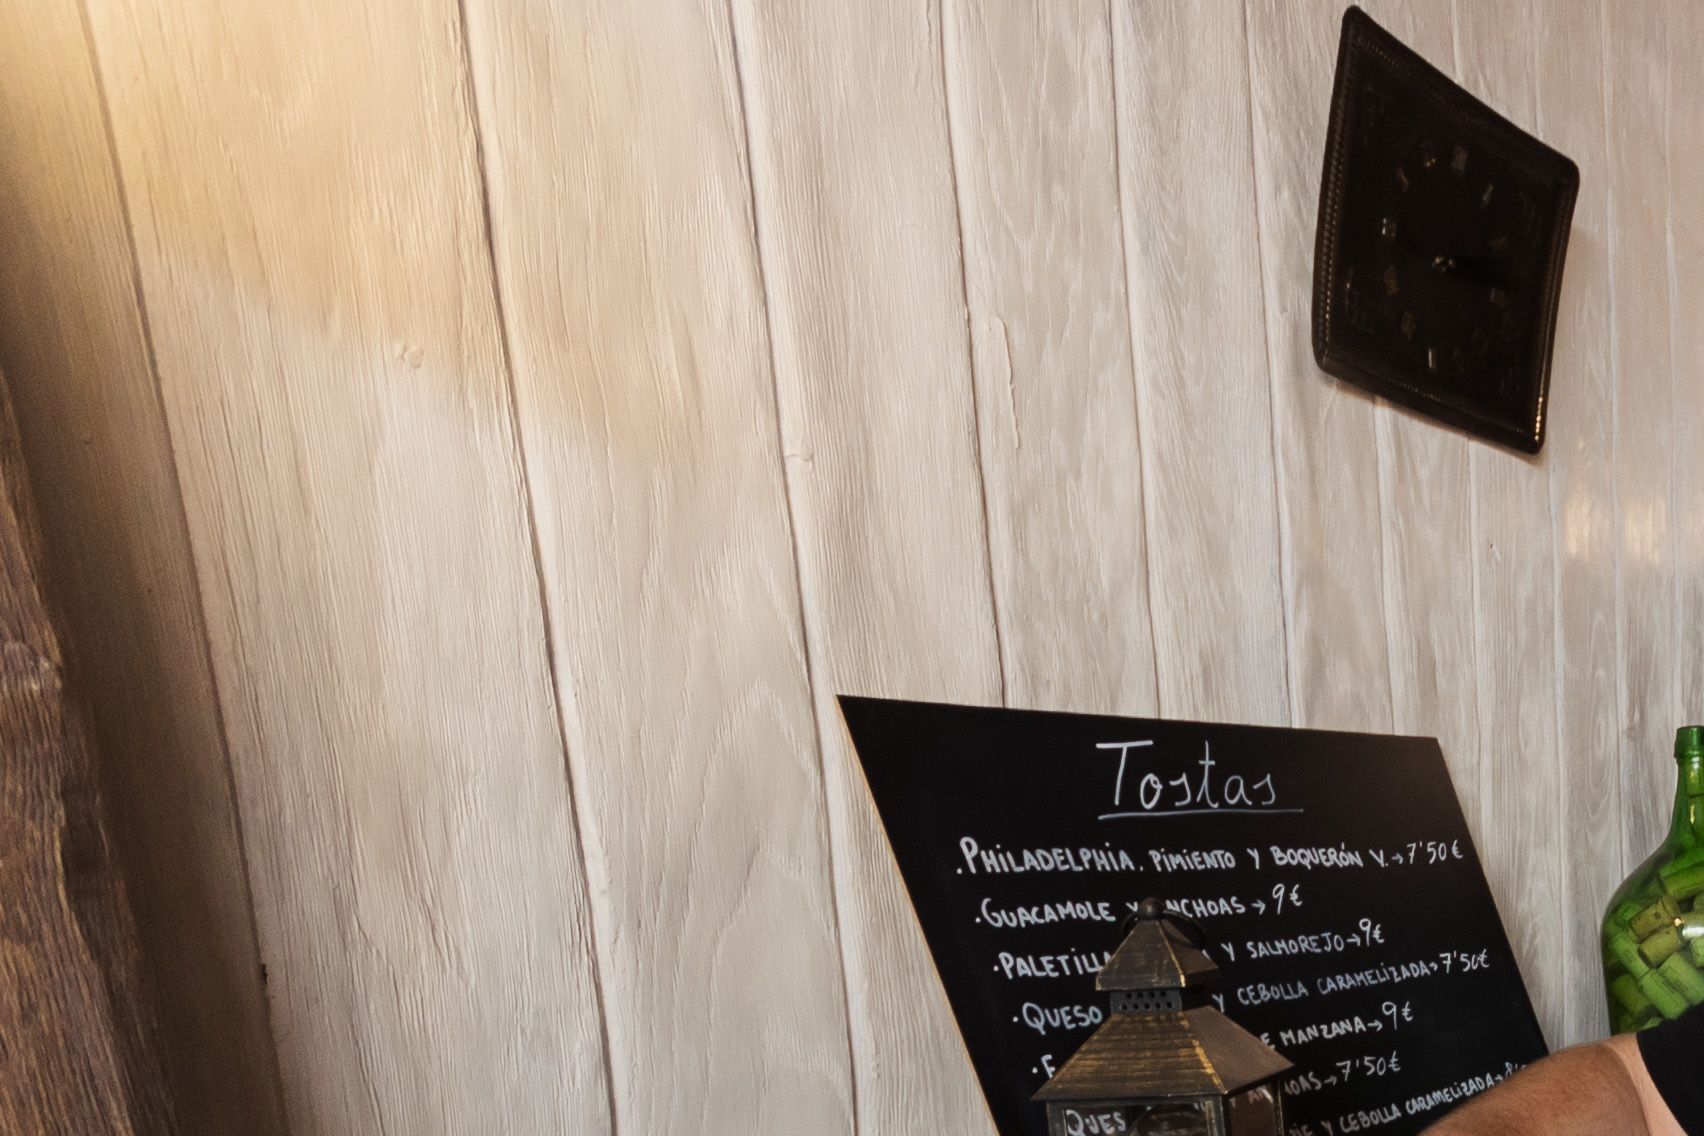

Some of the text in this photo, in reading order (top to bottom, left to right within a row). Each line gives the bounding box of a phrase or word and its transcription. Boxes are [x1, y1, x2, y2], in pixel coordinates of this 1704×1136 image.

[1096, 740, 1278, 808] Tostas
[1149, 847, 1236, 873] PIMIENTO
[1247, 847, 1260, 870] Y
[1269, 842, 1364, 870] BOQUERÓN
[981, 897, 1117, 929] GUACAMOLE
[1165, 896, 1246, 919] NCHOAS
[1221, 943, 1235, 962] Y
[1247, 932, 1345, 959] SALMOREJO
[1022, 1002, 1103, 1035] QUESO
[1212, 993, 1225, 1013] Y
[1237, 982, 1309, 1005] CEBOLLA
[1316, 962, 1432, 995] CARAMELIZADA
[1279, 1016, 1367, 1048] MANZANA
[1320, 1120, 1334, 1136] Y
[1339, 1103, 1402, 1135] CEBOLLA
[1405, 1072, 1495, 1116] CARAMELIZADA
